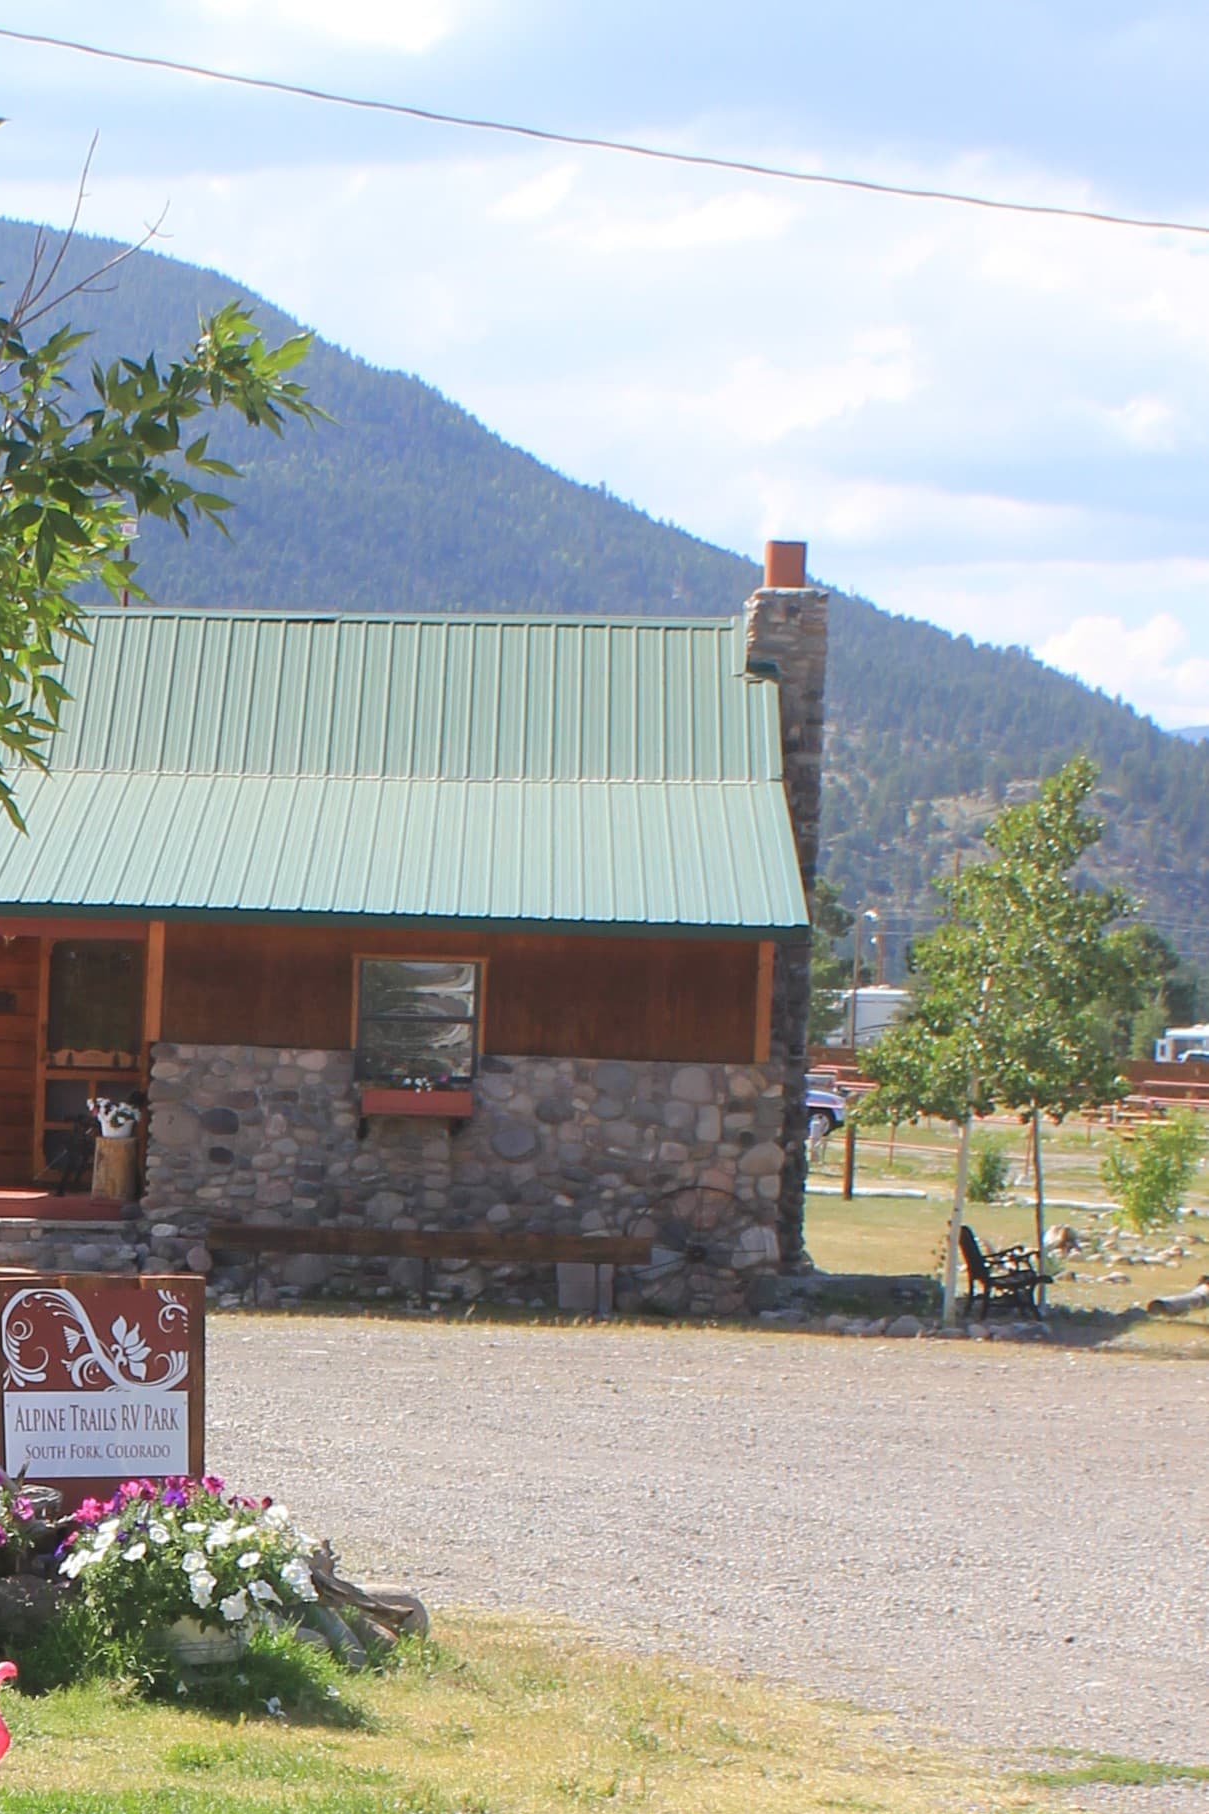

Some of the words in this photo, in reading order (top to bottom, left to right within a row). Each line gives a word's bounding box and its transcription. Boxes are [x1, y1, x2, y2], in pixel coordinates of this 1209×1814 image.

[14, 1405, 66, 1432] ALPINE
[69, 1404, 117, 1431] TRAILS
[121, 1404, 140, 1430] RV
[145, 1404, 180, 1431] PARK
